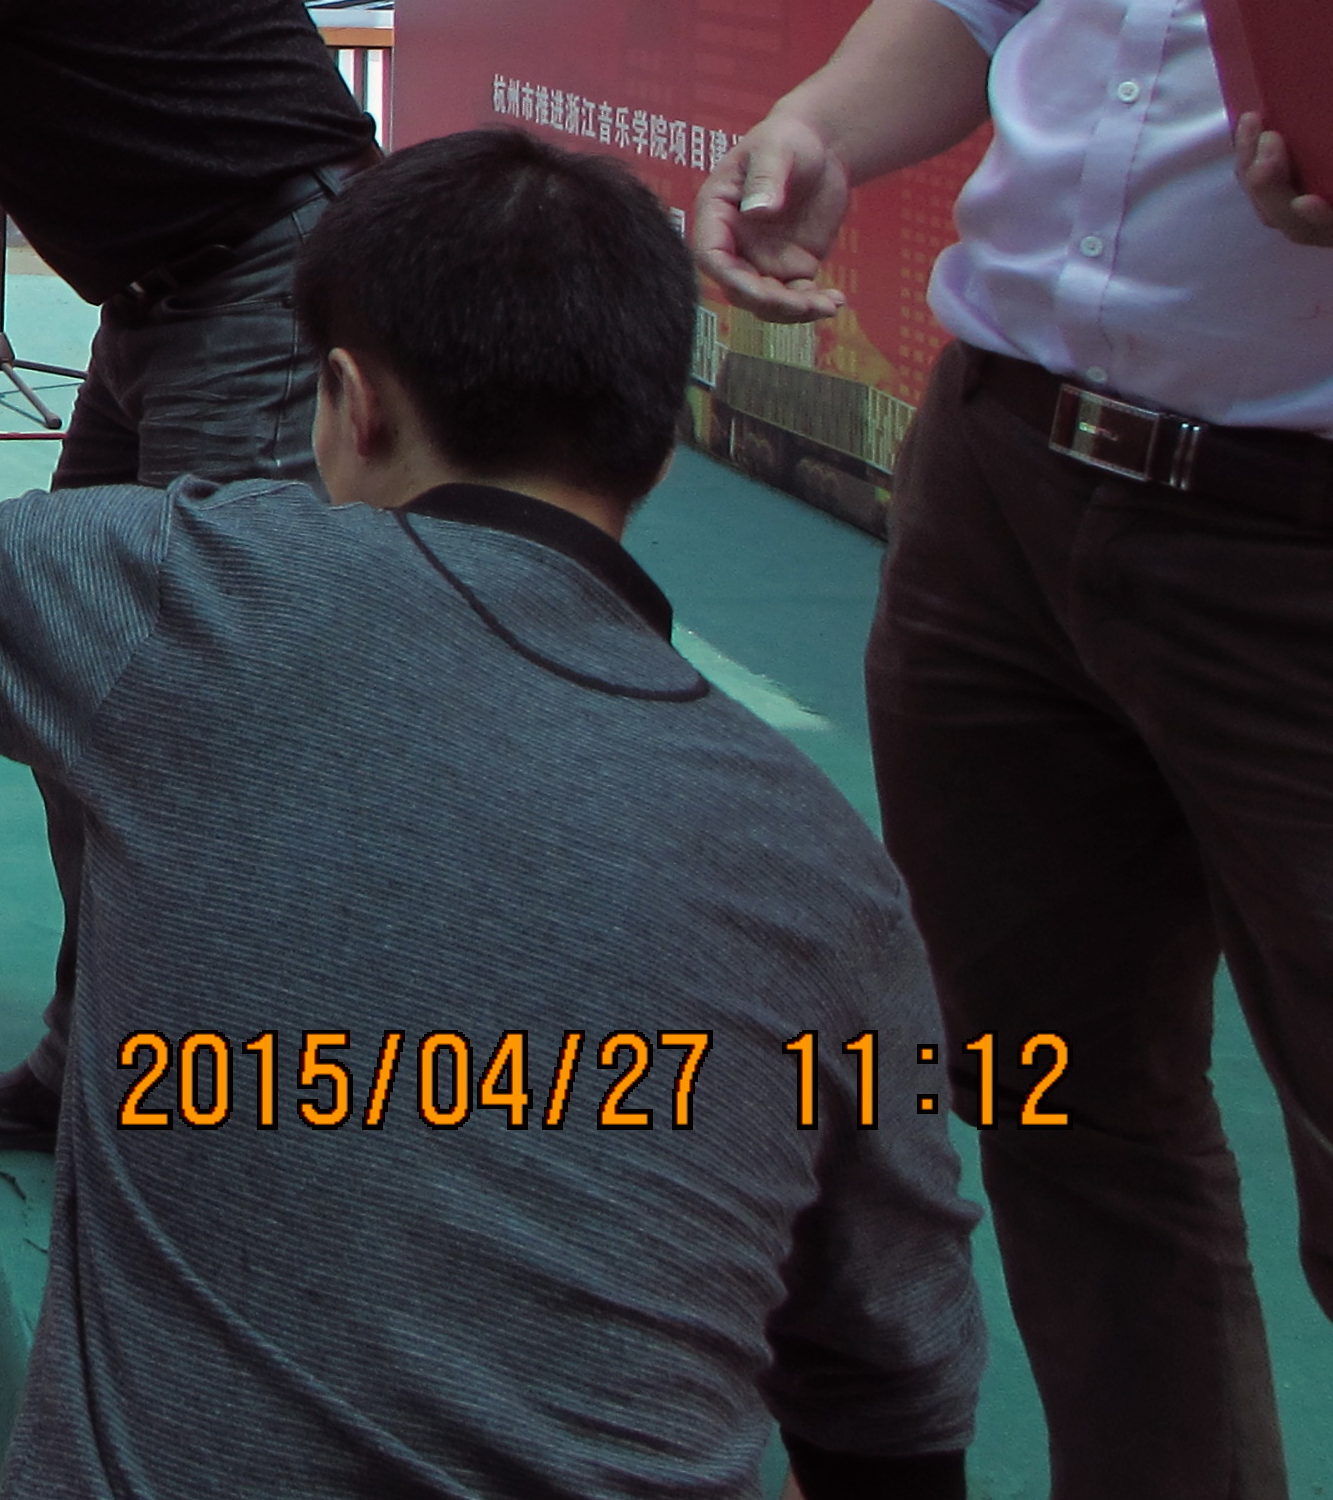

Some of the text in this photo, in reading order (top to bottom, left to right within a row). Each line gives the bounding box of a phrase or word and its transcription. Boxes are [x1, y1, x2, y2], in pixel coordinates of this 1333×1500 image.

[493, 73, 745, 172] 杭州市推进浙江音乐学院项目建
